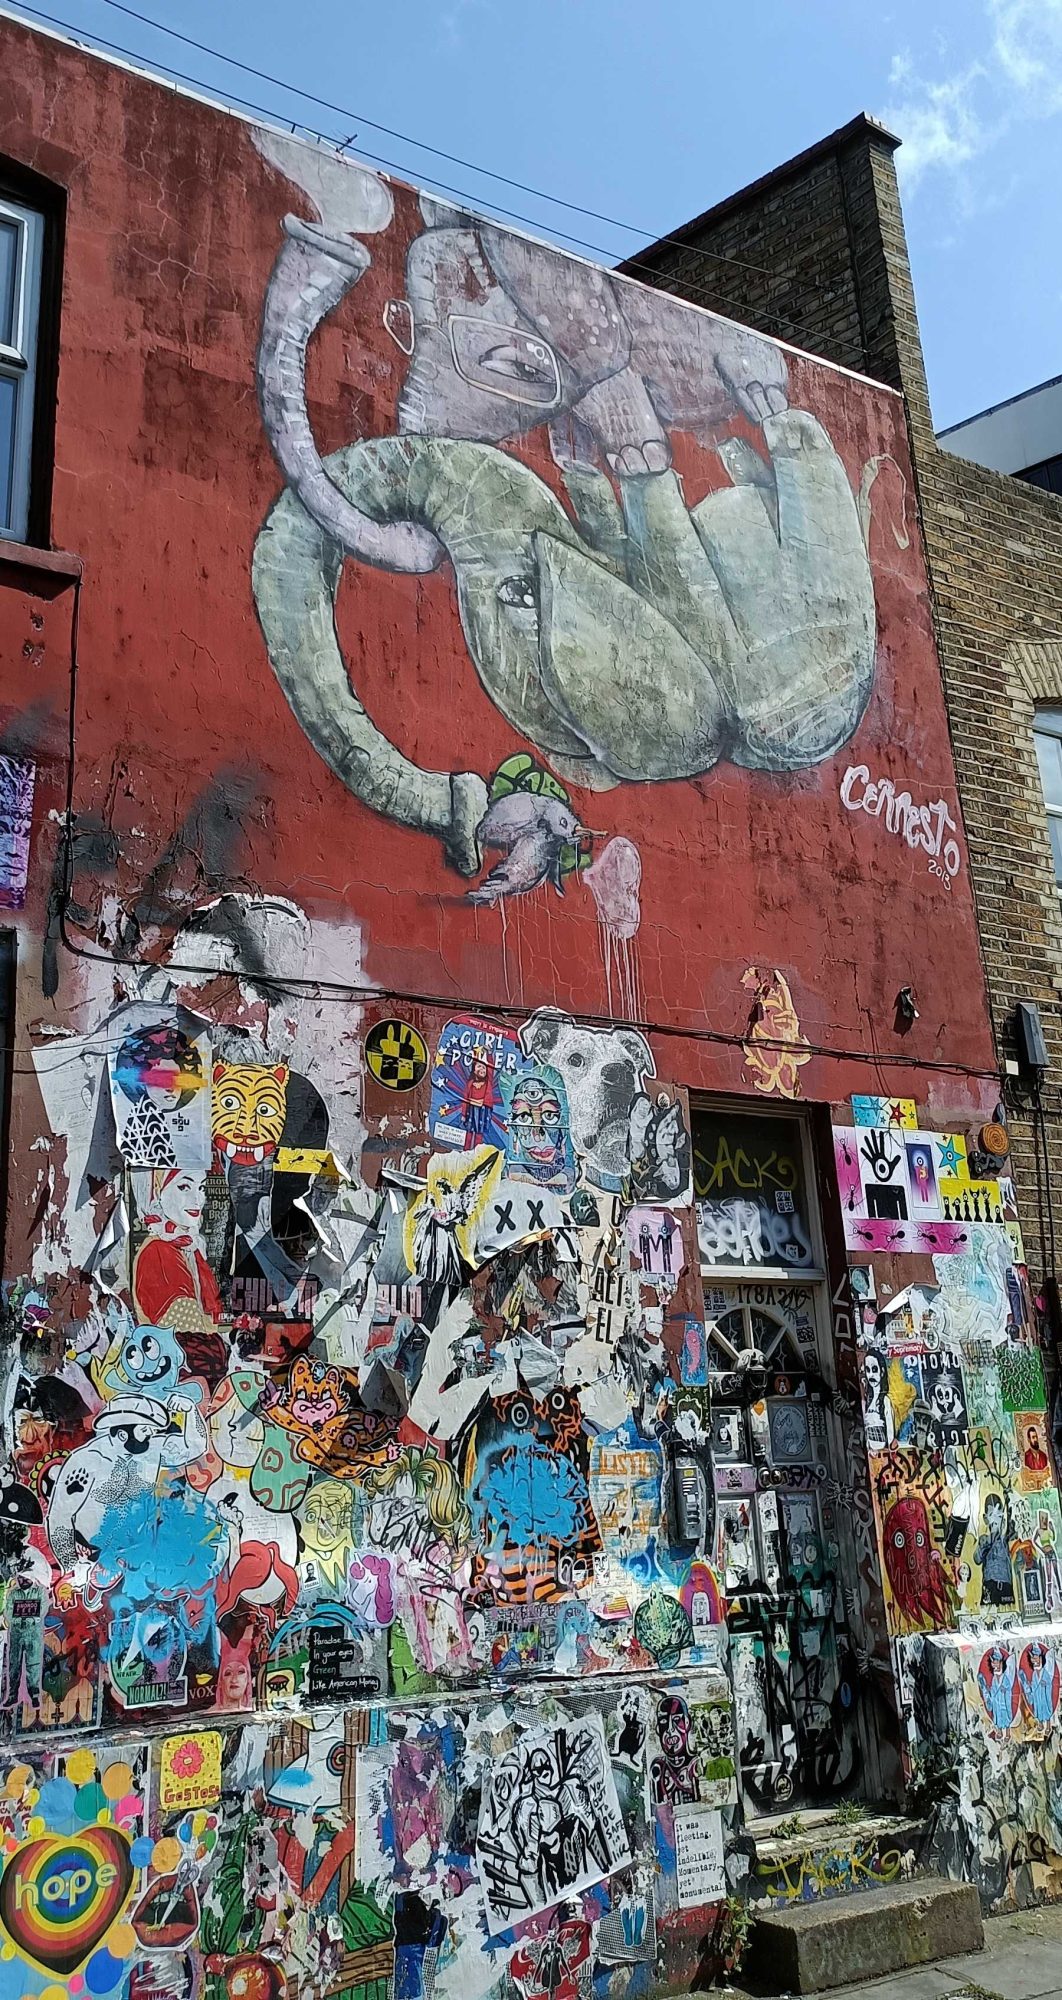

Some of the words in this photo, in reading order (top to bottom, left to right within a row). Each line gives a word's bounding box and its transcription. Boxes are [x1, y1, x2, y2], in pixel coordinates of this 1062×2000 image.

[460, 1031, 504, 1049] GIRL
[451, 1049, 517, 1069] POWER
[737, 1286, 777, 1306] 178A
[920, 1352, 961, 1370] HOMO
[313, 1632, 341, 1645] Paradise
[313, 1649, 320, 1659] In
[322, 1651, 337, 1664] your
[338, 1649, 353, 1659] eyes
[312, 1664, 336, 1675] Green
[685, 1822, 699, 1830] was
[677, 1845, 689, 1856] yet
[15, 1863, 118, 1910] hope
